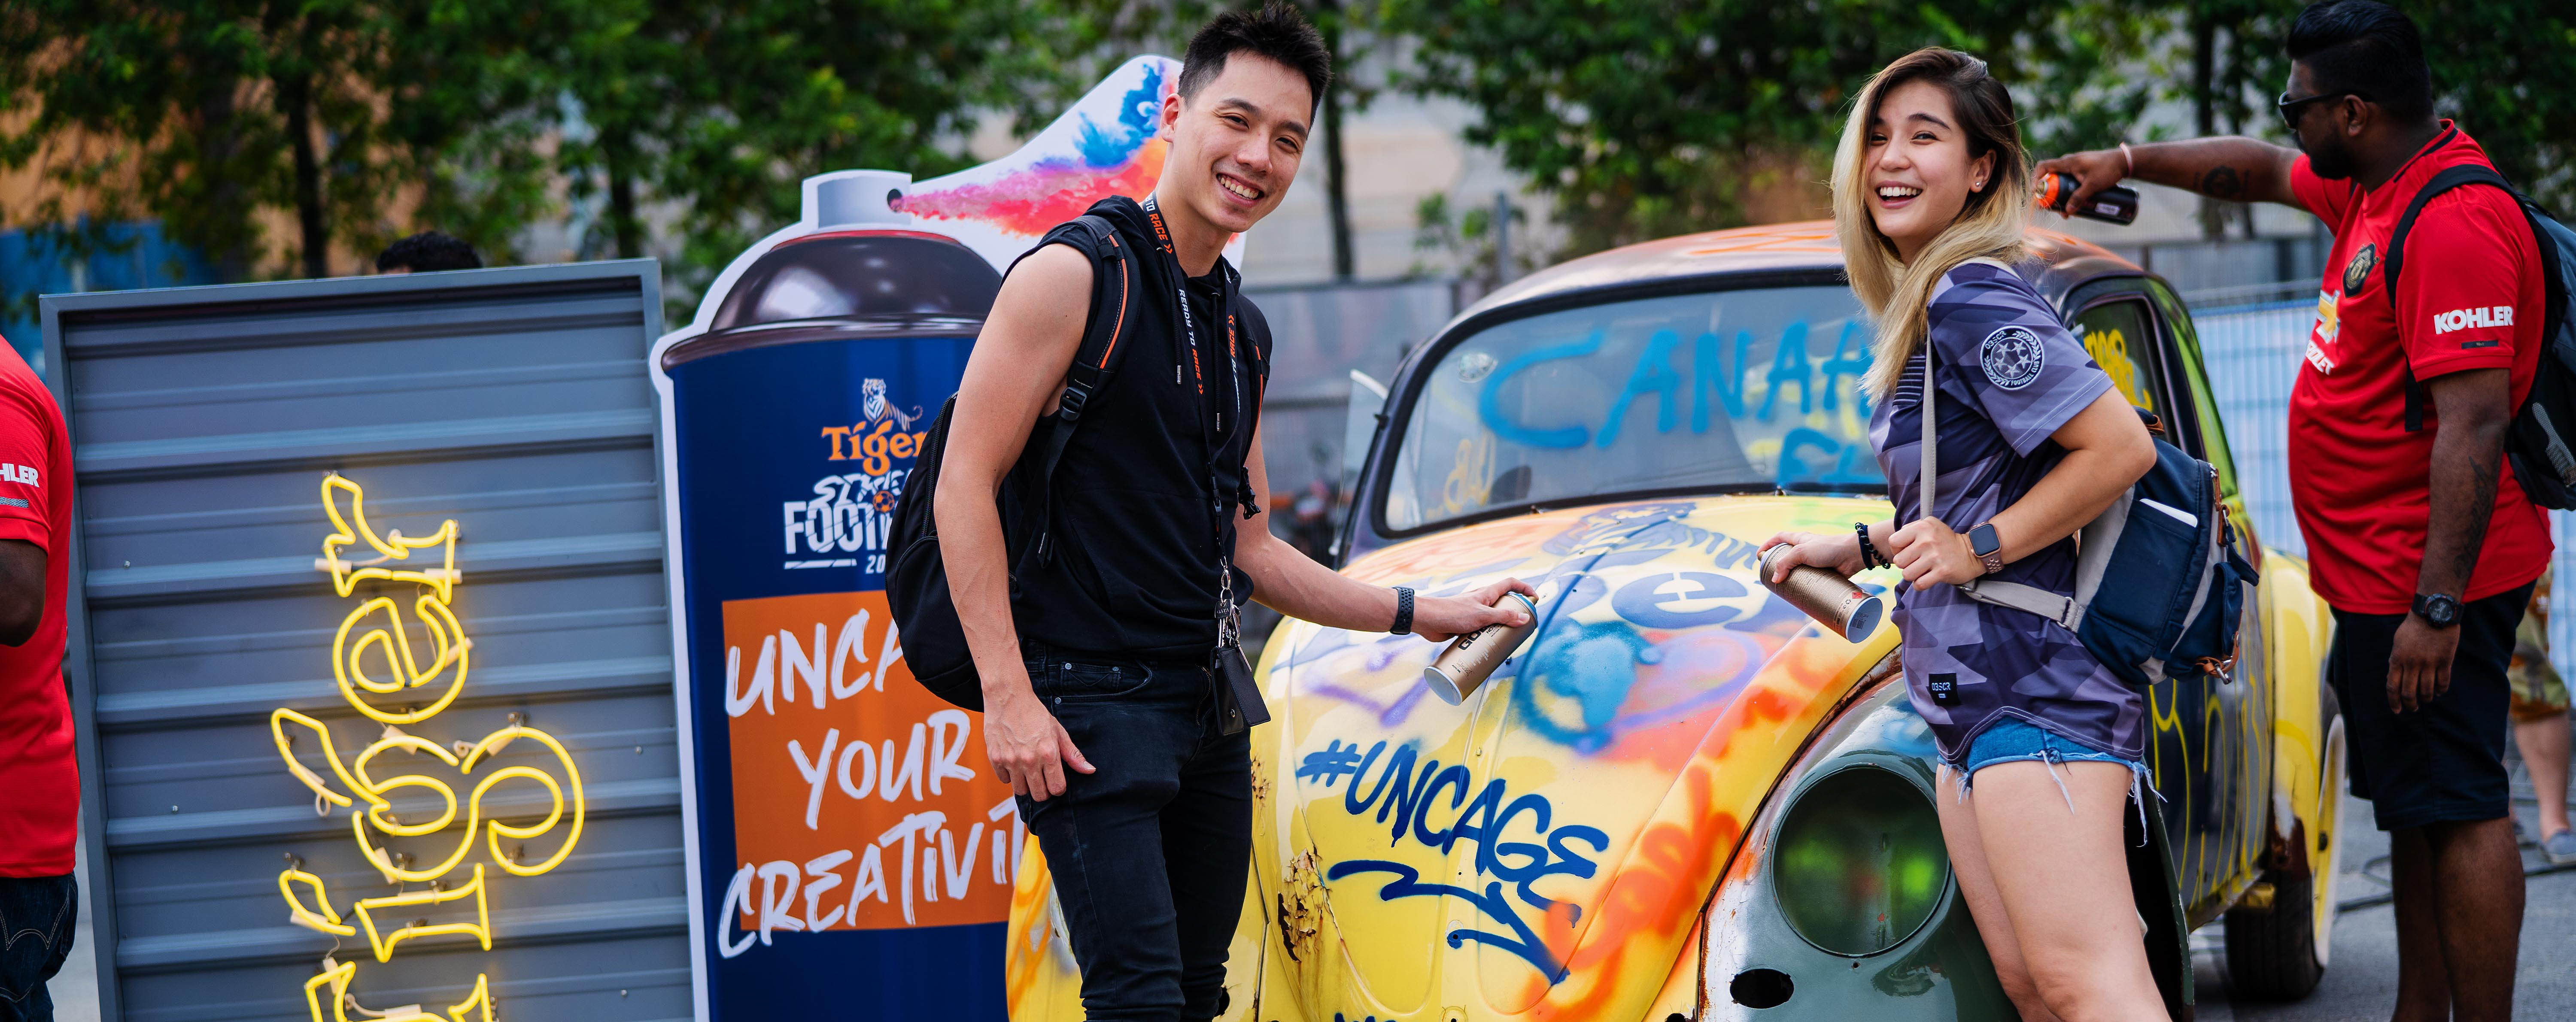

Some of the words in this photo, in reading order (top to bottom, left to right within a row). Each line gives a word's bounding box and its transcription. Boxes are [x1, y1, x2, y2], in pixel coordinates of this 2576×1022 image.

[1145, 200, 1155, 212] TO
[1149, 213, 1168, 240] RACE
[2433, 306, 2513, 334] KOHLER
[1179, 289, 1192, 328] READY
[1189, 331, 1195, 346] TO
[1192, 349, 1201, 381] RACE
[2011, 373, 2034, 385] FOOTBALL
[2031, 361, 2039, 373] CLUB
[788, 709, 975, 829] YOUR
[1296, 739, 1610, 928] #UNCAGE
